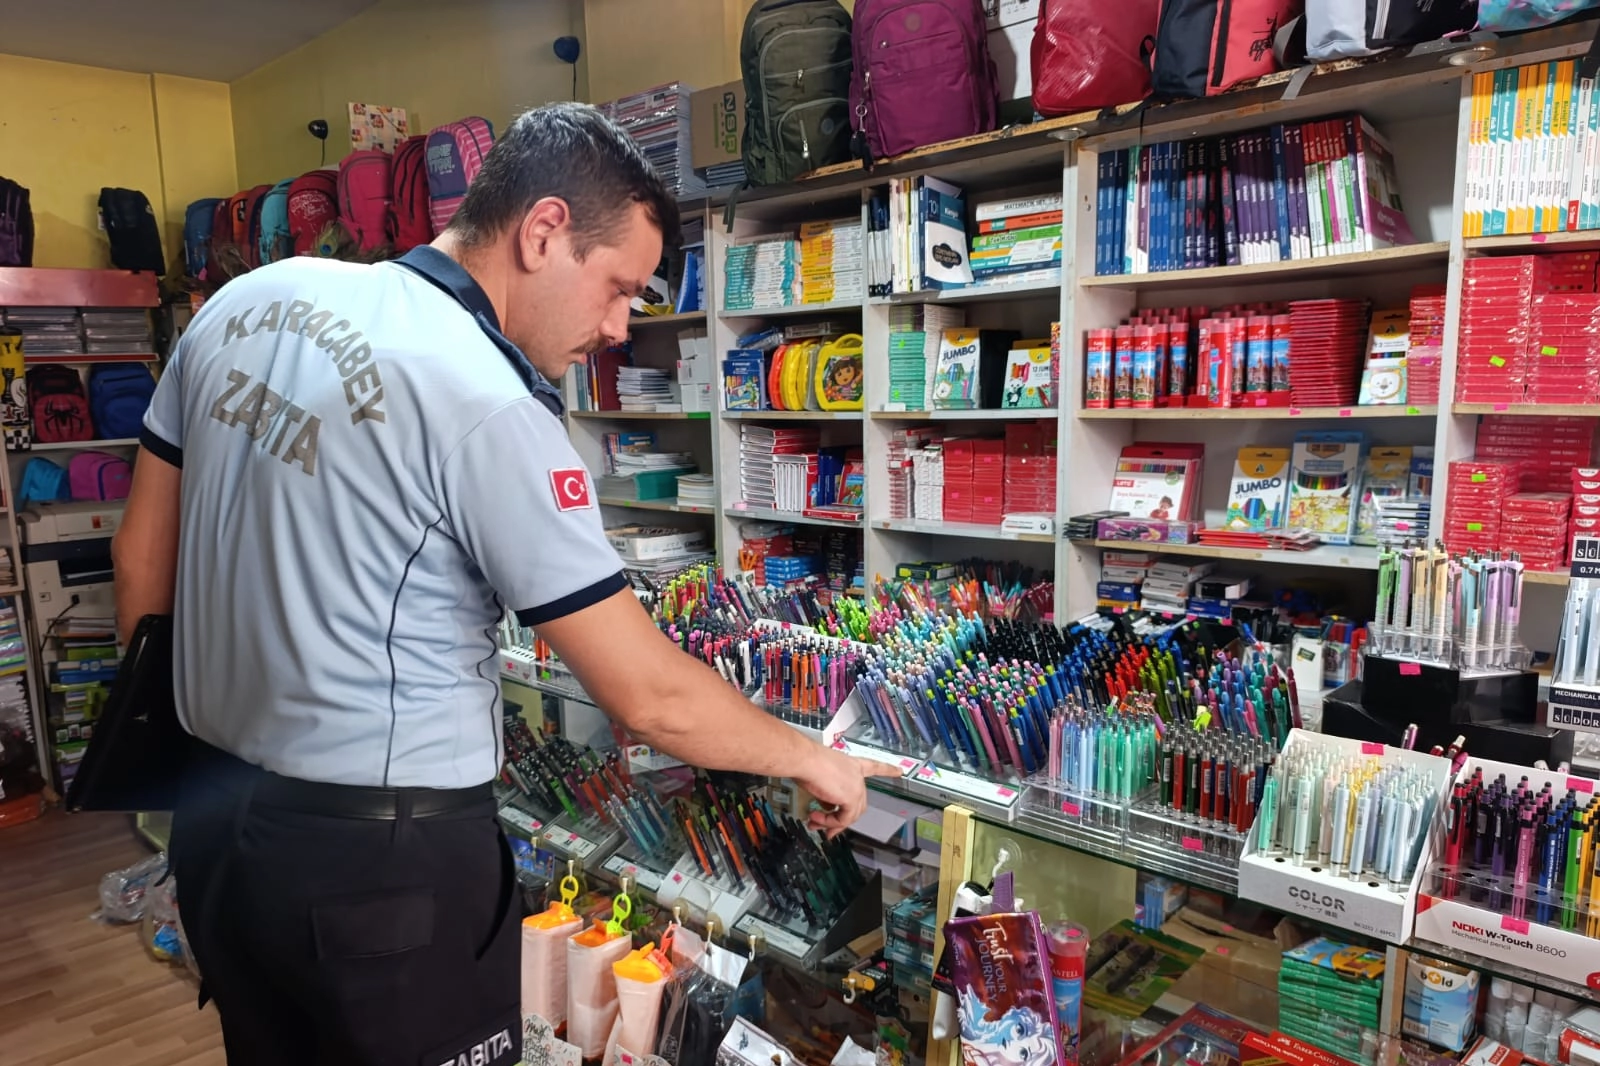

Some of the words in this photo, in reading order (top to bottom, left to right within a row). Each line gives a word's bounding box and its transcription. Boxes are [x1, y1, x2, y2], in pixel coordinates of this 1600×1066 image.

[222, 298, 386, 426] KARACABEY
[942, 344, 976, 362] JUMBO
[210, 368, 322, 476] ZABITA
[1234, 476, 1282, 495] JUMBO
[1580, 566, 1593, 574] 0.7
[1554, 690, 1597, 700] MECHANICAL
[1288, 886, 1346, 912] COLOR
[982, 922, 1014, 965] Trust
[1452, 920, 1484, 936] NOKI
[1486, 930, 1534, 950] W-Touch
[1536, 943, 1567, 958] 8600
[1452, 929, 1489, 945] Mechanical
[1490, 940, 1512, 952] pencil
[974, 938, 998, 1002] JOURNEY
[994, 962, 1008, 993] YOUR
[1052, 970, 1079, 978] ASTELL
